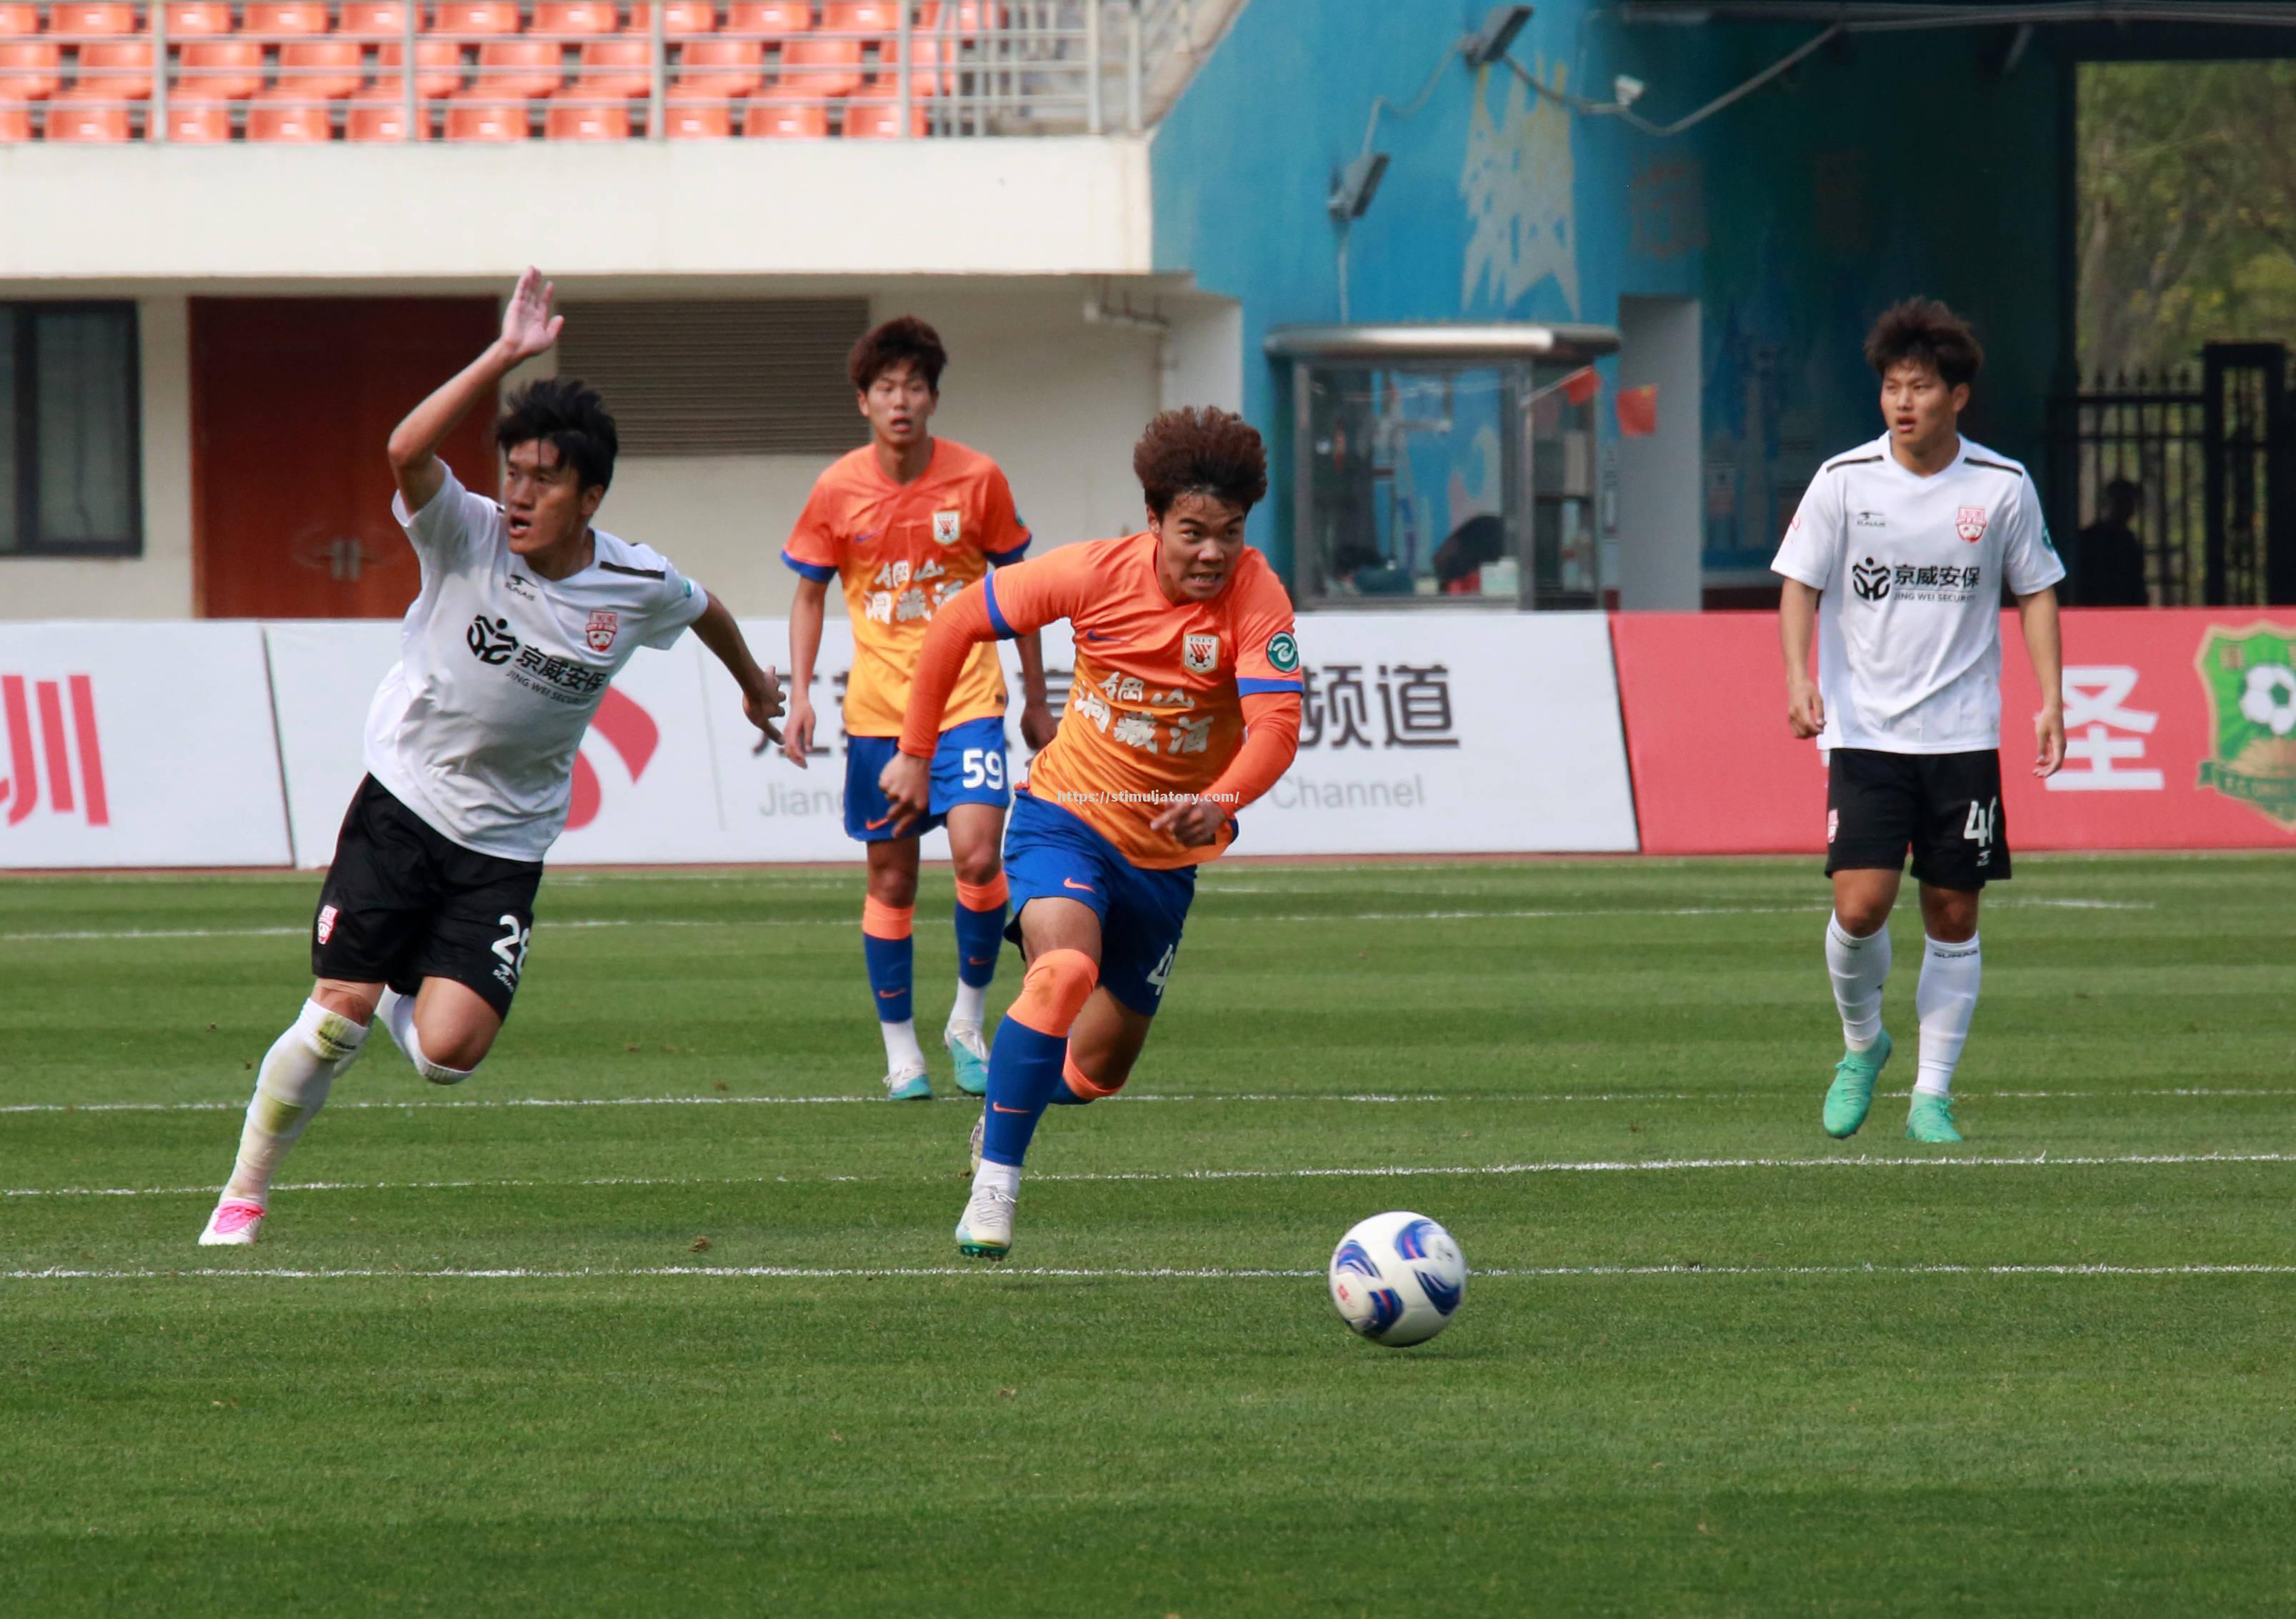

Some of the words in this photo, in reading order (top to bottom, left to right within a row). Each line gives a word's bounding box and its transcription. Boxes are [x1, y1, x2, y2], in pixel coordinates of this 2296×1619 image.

[1895, 564, 1980, 588] 京威安保
[516, 644, 607, 693] 京威安保
[2034, 664, 2165, 791] 圣
[962, 749, 1004, 790] 59
[759, 783, 844, 817] Jian
[1271, 773, 1425, 810] Channel
